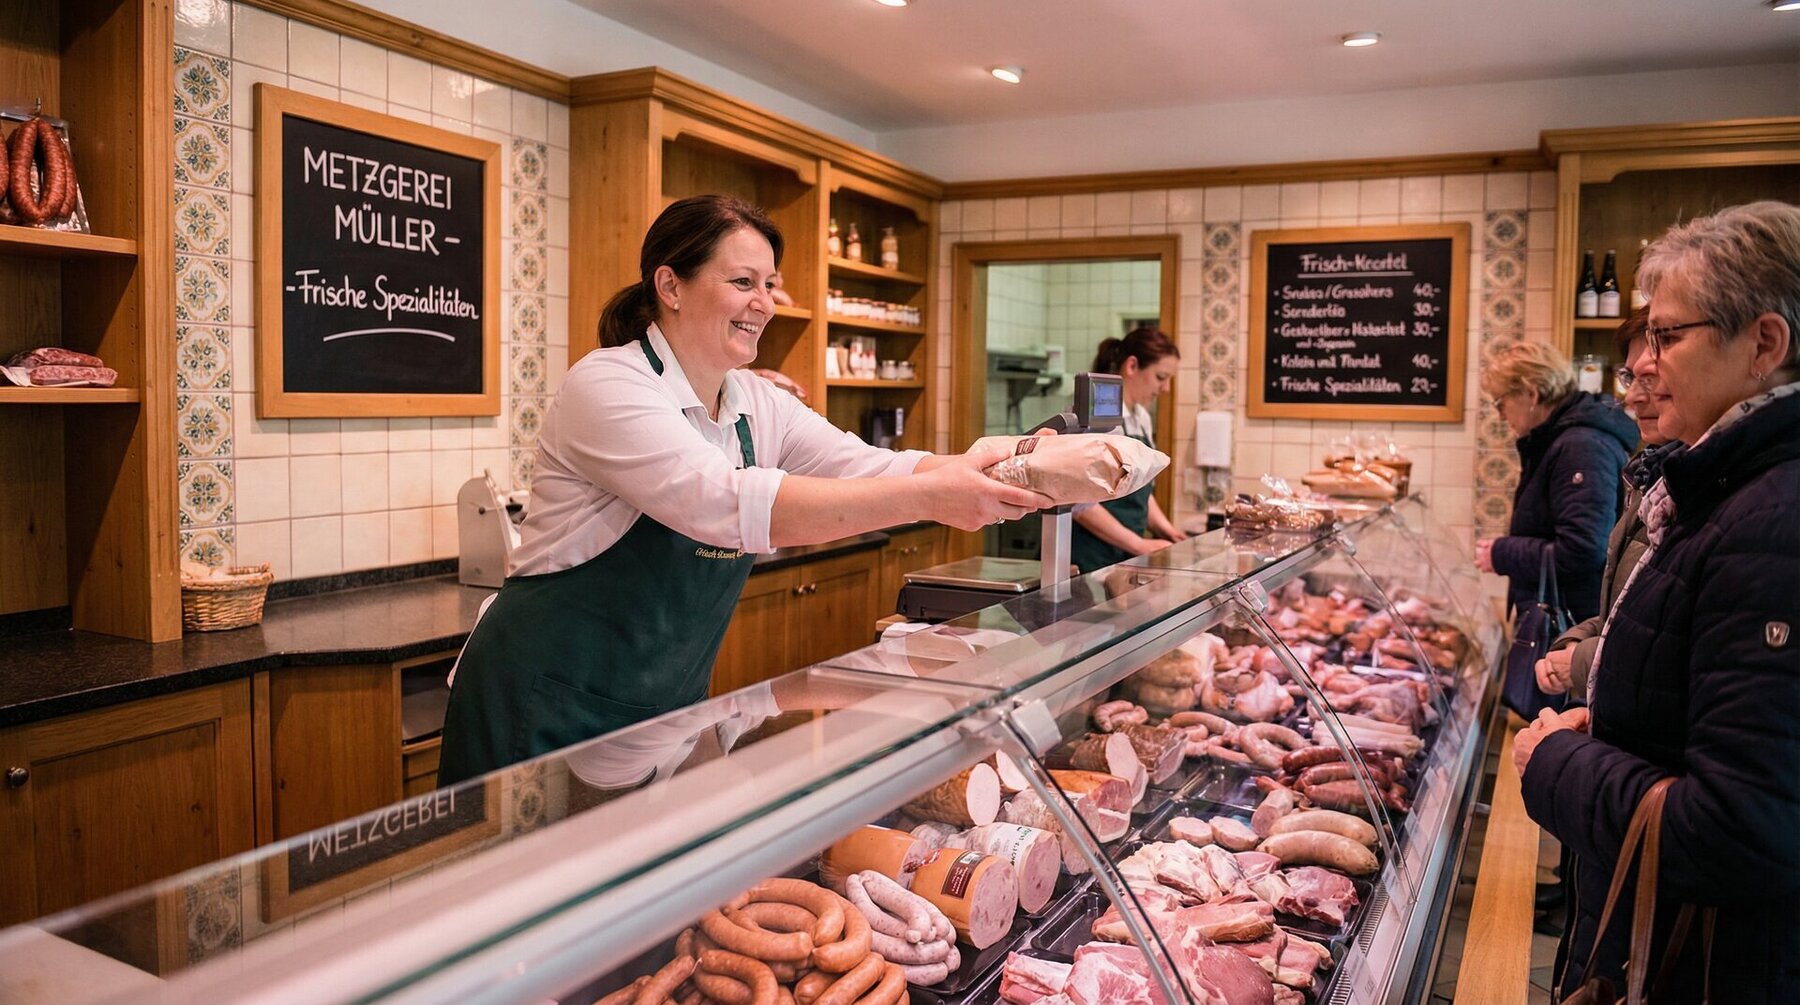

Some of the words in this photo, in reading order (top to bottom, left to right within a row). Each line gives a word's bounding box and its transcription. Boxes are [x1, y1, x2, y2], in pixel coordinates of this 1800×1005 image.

[303, 146, 451, 210] METZGEREI
[335, 200, 441, 255] MÜLLER
[373, 275, 479, 321] Spezialitäten
